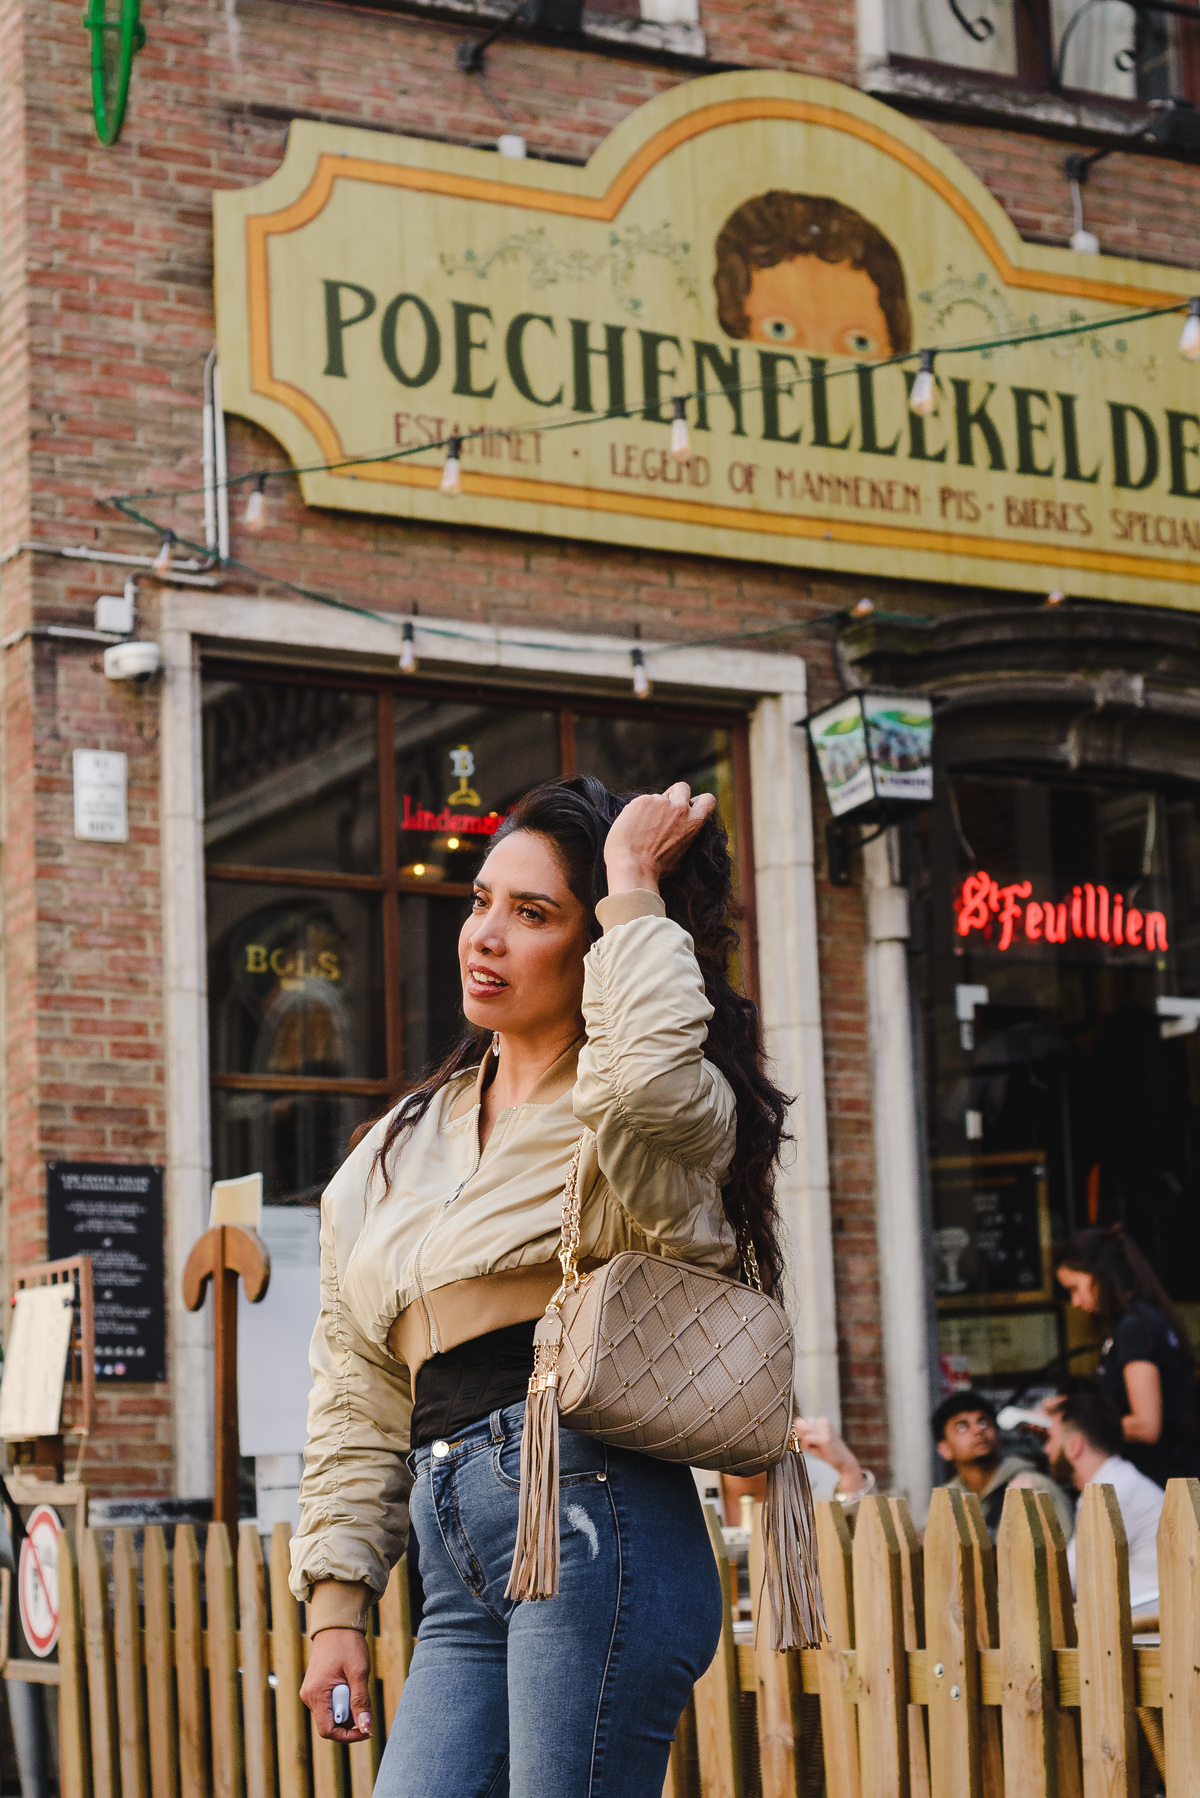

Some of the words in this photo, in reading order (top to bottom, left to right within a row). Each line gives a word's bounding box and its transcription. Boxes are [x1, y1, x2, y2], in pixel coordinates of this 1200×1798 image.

[728, 460, 758, 495] OF
[775, 466, 922, 516] MANNEKEN
[938, 485, 982, 524] PIS
